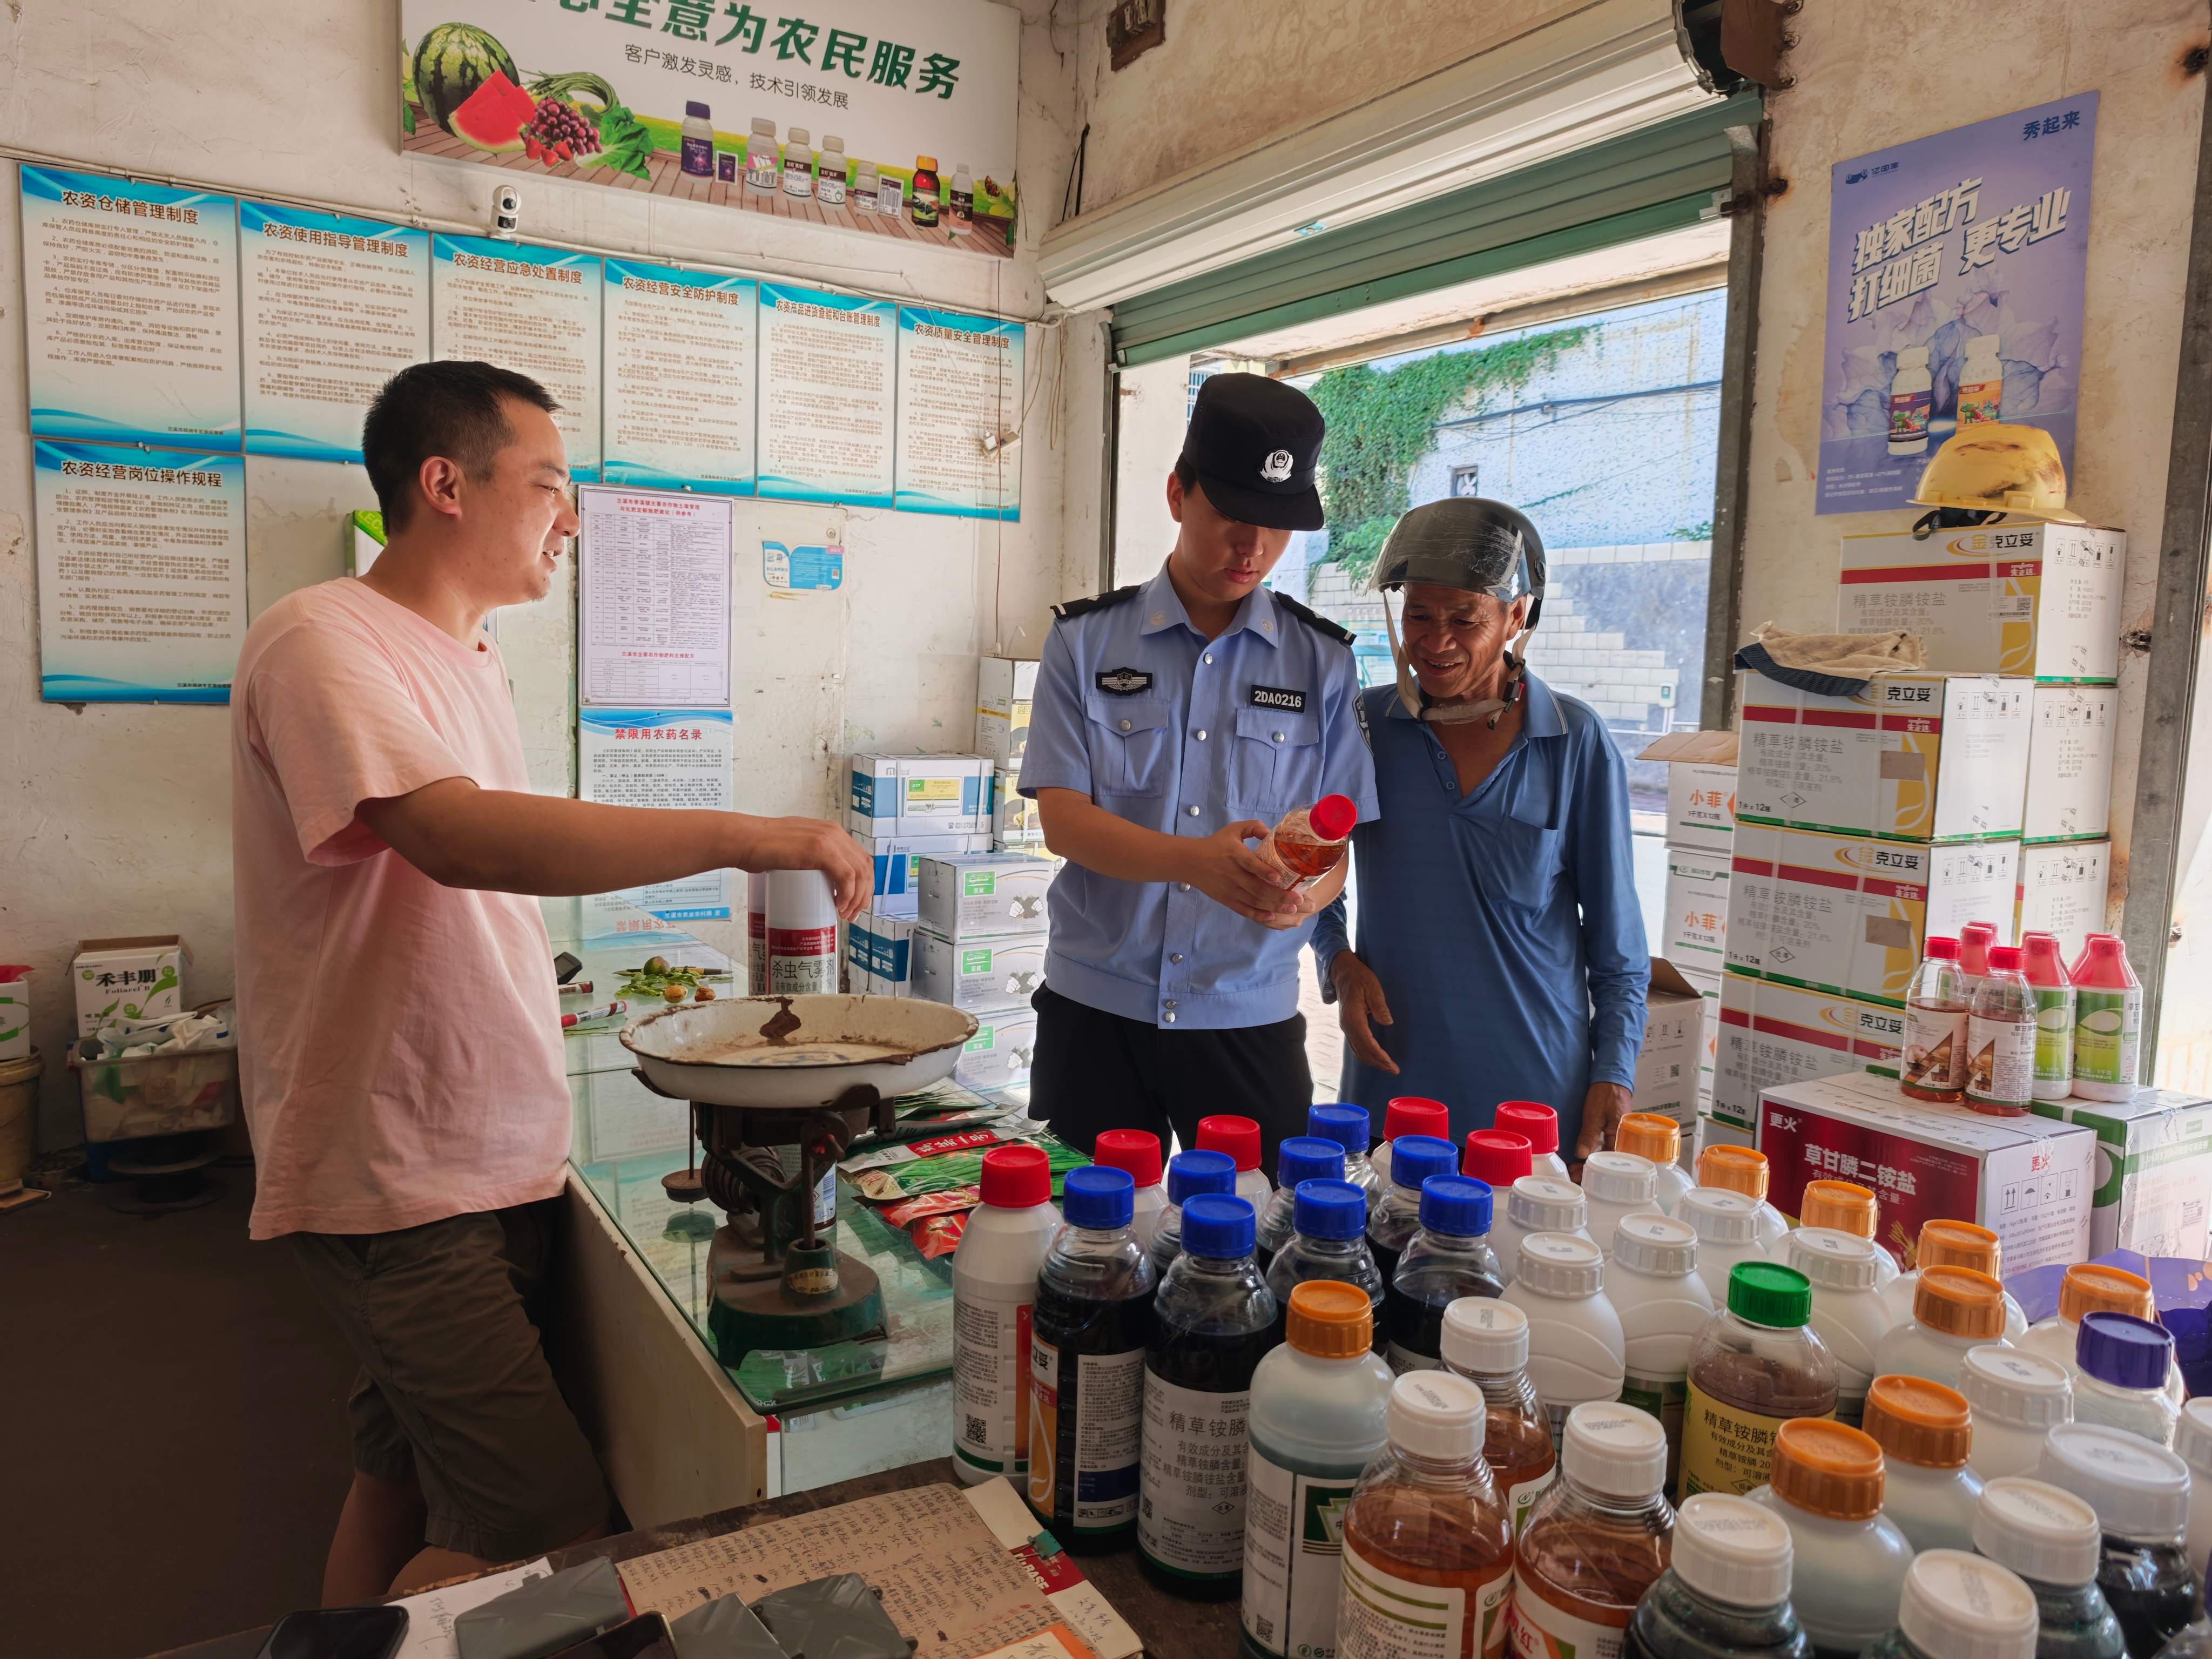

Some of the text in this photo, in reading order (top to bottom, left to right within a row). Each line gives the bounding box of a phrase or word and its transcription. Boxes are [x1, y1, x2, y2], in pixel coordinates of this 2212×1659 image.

[625, 44, 848, 110] 客户激发灵感，技术引领发展
[2024, 110, 2081, 140] 秀起来
[62, 190, 199, 225] 农资仓储管理制度
[1853, 176, 1984, 275] 独家配方
[1958, 186, 2072, 276] 更专业
[264, 222, 408, 258] 农资使用指导管理制度
[454, 253, 582, 285] 农资经营应急处置制度
[1847, 242, 1945, 323] 打细菌
[623, 276, 739, 306] 农资经营安全防护制度
[775, 300, 881, 328] 农资产品进货查验和台账管理制度
[915, 323, 1009, 349] 农资质量安全管理制度
[62, 461, 222, 487] 农资经营岗位操作规程
[1853, 592, 1946, 609] 精草铵膦铵盐
[1254, 690, 1302, 708] 2DA0216
[615, 728, 703, 740] 禁限用农药名录
[1689, 789, 1722, 808] 小菲
[1684, 911, 1717, 932] 小菲
[772, 958, 835, 979] 杀虫气雾剂
[1769, 1111, 1797, 1132] 更火
[1804, 1143, 1917, 1196] 草甘膦二铵盐
[2032, 1154, 2051, 1171] 更火
[1169, 1410, 1246, 1438] 精草铵膦
